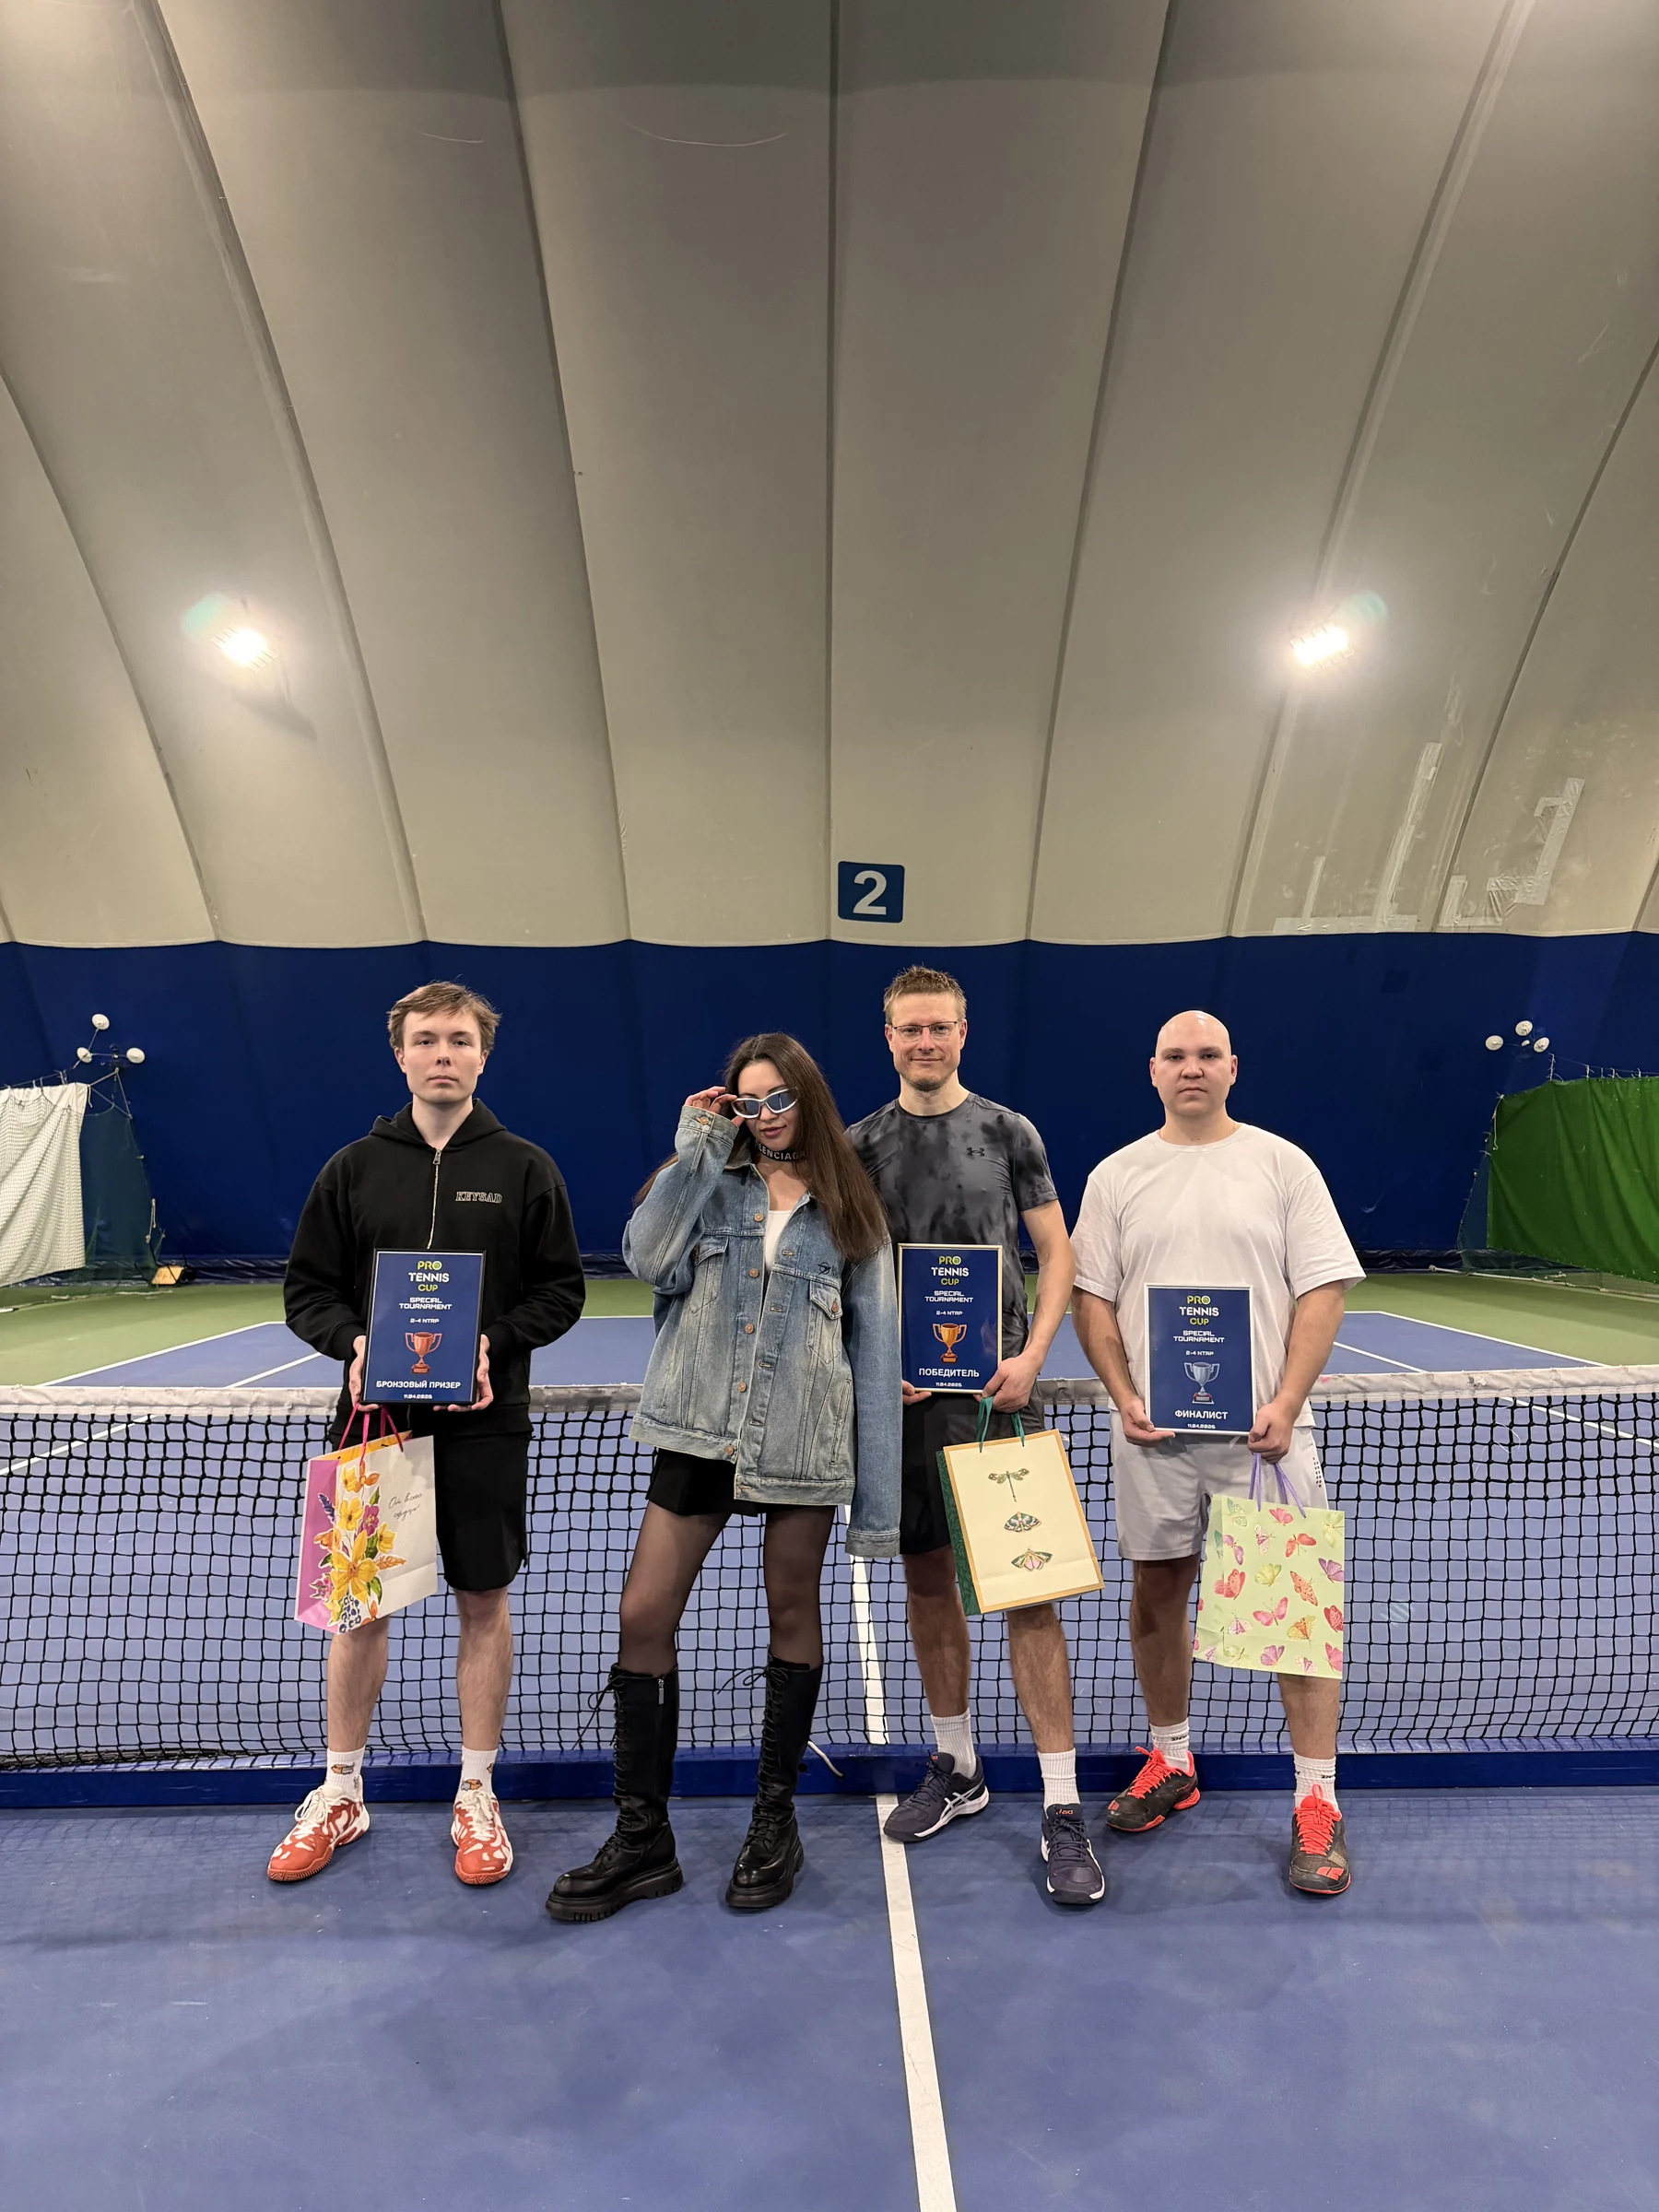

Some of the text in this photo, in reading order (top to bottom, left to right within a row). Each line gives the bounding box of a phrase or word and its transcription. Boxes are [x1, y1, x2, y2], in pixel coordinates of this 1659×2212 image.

[853, 870, 887, 915] 2
[938, 1255, 961, 1265] PRO
[417, 1260, 442, 1271] PRO
[931, 1266, 969, 1277] TENNIS
[408, 1272, 450, 1283] TENNIS
[1186, 1295, 1211, 1305] PRO
[1179, 1306, 1219, 1317] TENNIS
[918, 1368, 980, 1378] ПОБЕДИТЕЛЬ
[376, 1380, 428, 1388] БРОНЗОВЫЙ
[1174, 1410, 1228, 1419] ФИНАЛИСТ
